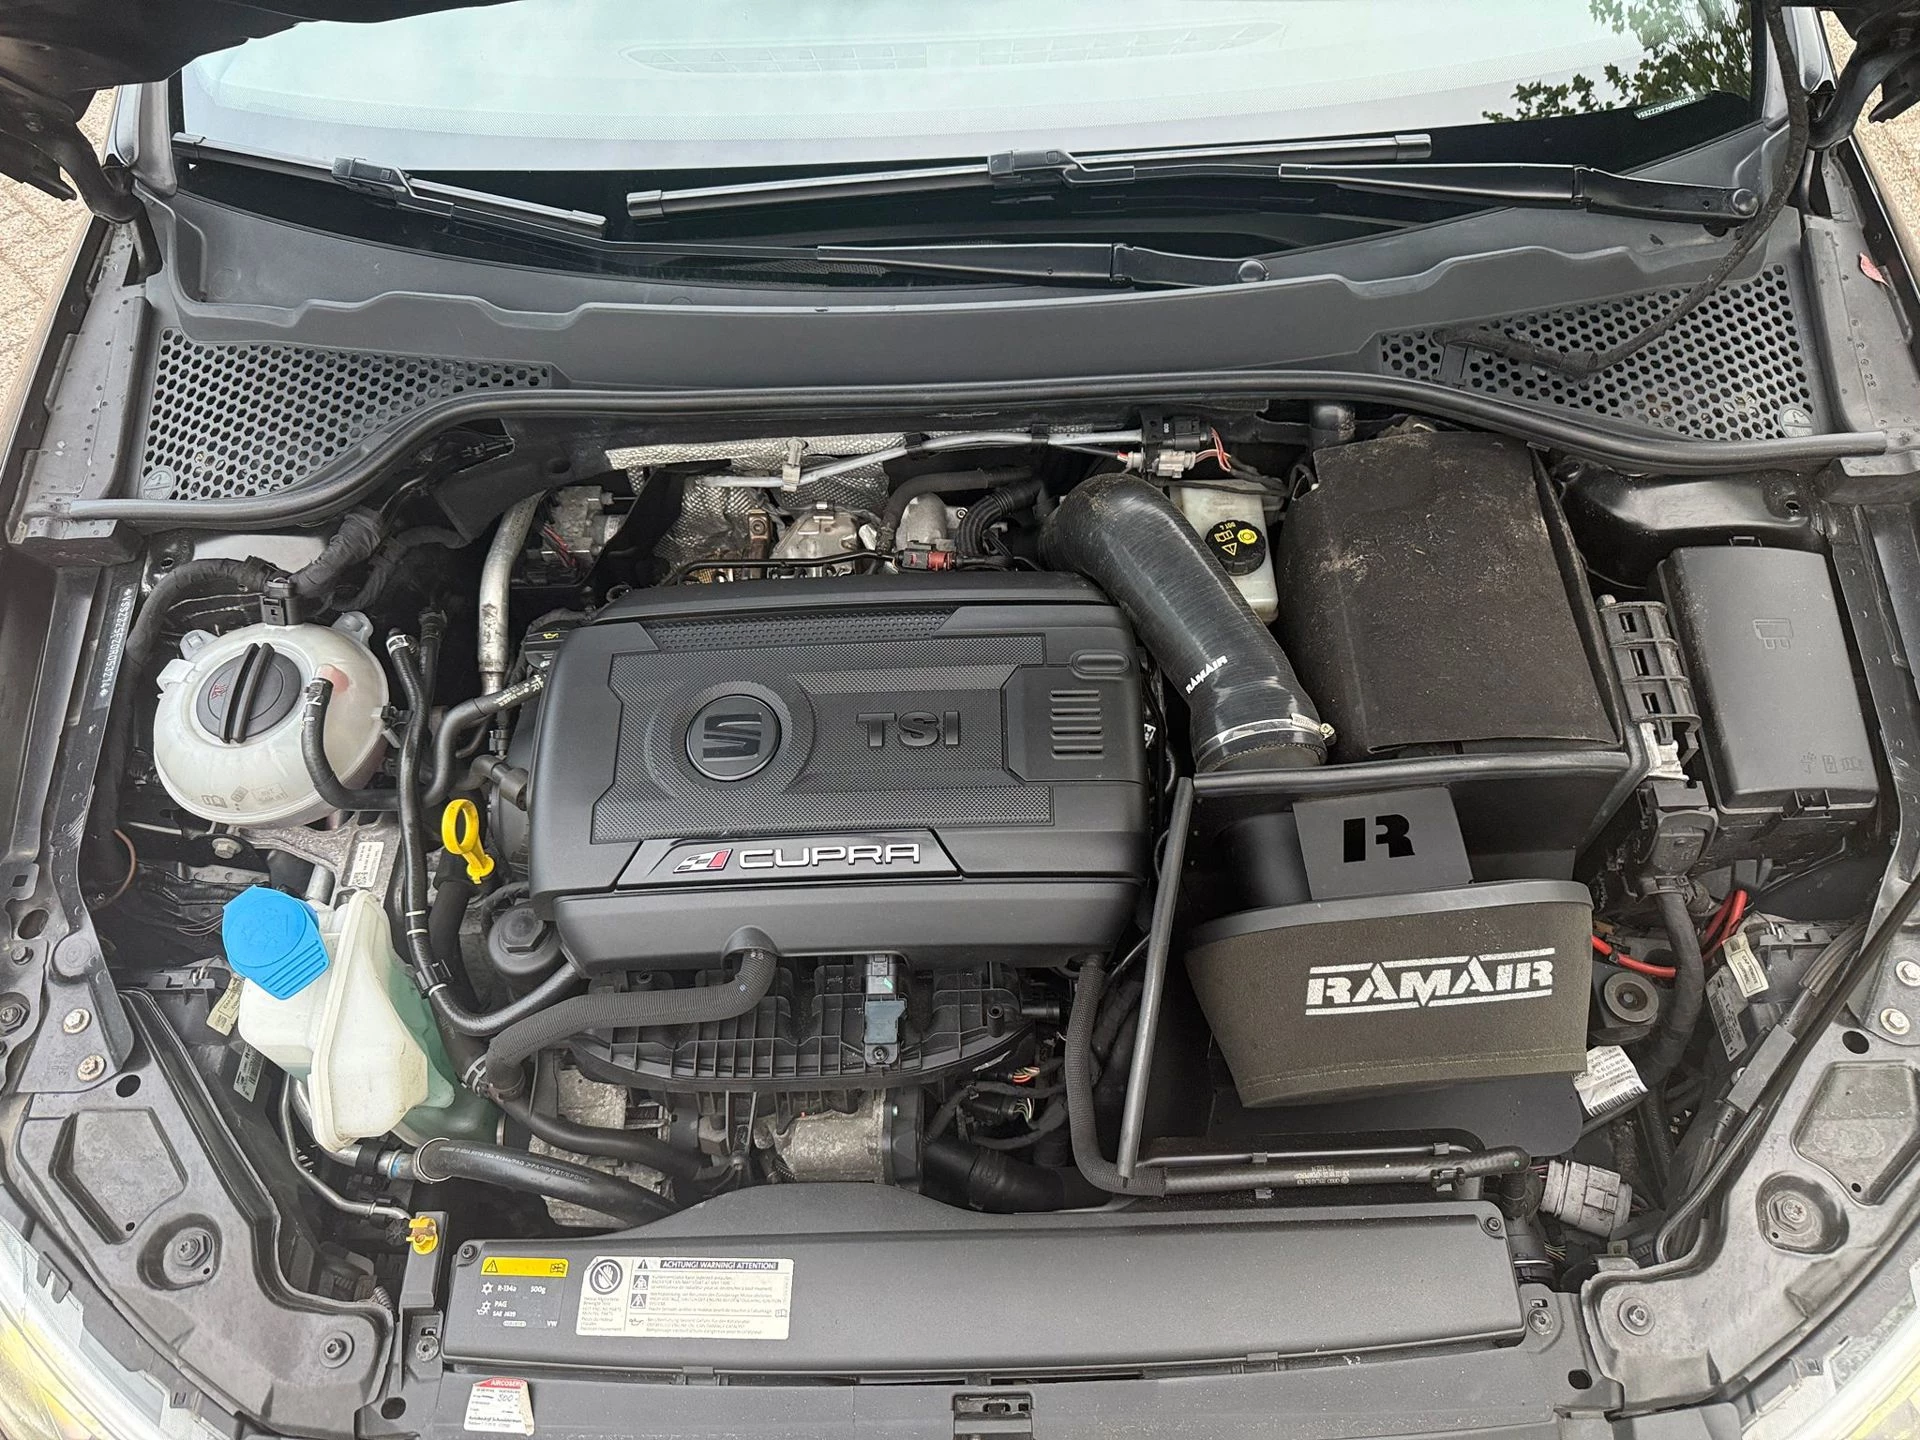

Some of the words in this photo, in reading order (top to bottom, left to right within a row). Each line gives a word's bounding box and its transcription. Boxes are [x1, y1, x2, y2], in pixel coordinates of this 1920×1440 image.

[1186, 655, 1228, 694] RAMAIR
[857, 710, 961, 748] TSI
[738, 843, 921, 870] CUPRA
[1343, 814, 1416, 863] R
[1306, 956, 1554, 1007] RAMAIR
[662, 1260, 698, 1269] ACHTUNG!
[700, 1261, 735, 1269] WARNING!
[736, 1261, 777, 1270] ATTENTION!
[530, 1286, 546, 1294] 500g
